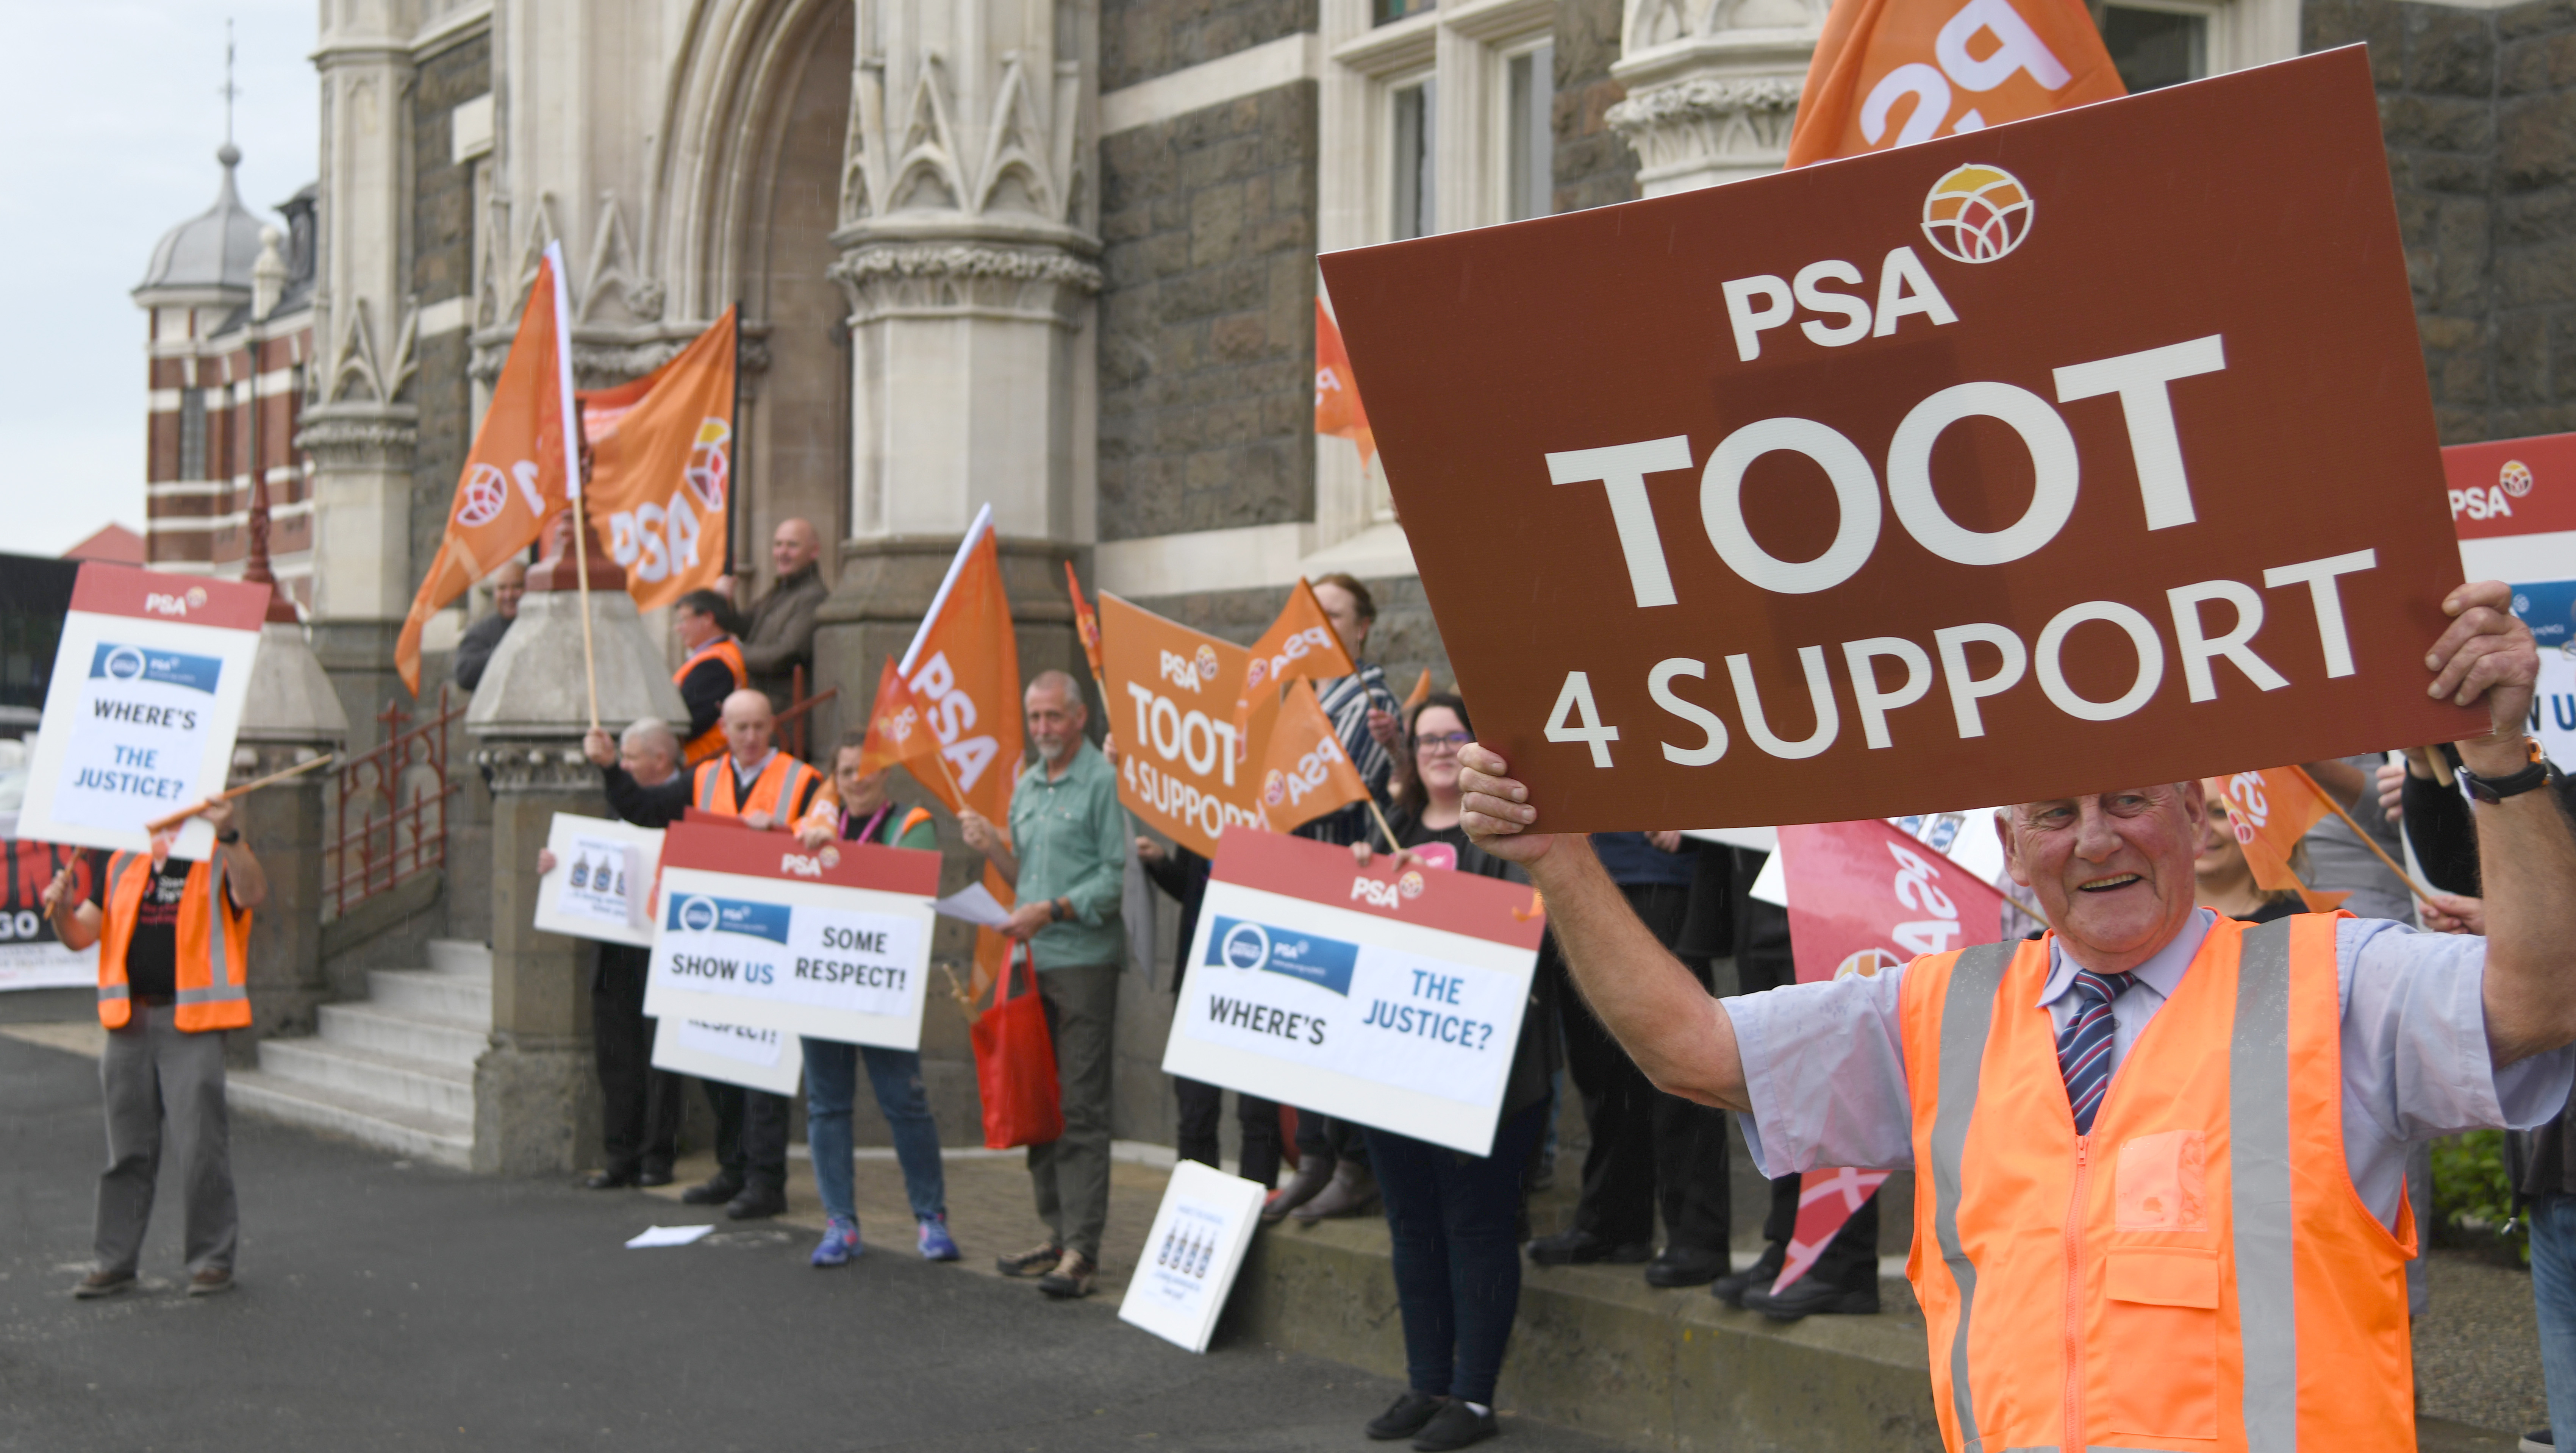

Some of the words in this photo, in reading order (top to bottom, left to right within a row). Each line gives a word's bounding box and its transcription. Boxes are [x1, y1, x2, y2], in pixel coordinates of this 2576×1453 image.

[1722, 247, 1958, 361] PSA
[1545, 334, 2225, 607] TOOT
[2448, 485, 2514, 523] PSA
[145, 592, 187, 617] PSA
[1160, 649, 1201, 694] PSA
[1543, 671, 1620, 768] 4
[1647, 548, 2376, 767] SUPPORT
[92, 698, 197, 730] WHERE'S
[909, 650, 1000, 794] PSA
[1127, 681, 1236, 787] TOOT
[114, 745, 158, 769] THE
[1124, 754, 1137, 792] 4
[73, 767, 184, 798] JUSTICE?
[782, 853, 822, 876] PSA
[1351, 876, 1399, 909] PSA
[823, 927, 887, 954] SOME
[672, 953, 739, 980] SHOW
[745, 962, 774, 985] US
[796, 958, 906, 991] RESPECT!
[1412, 969, 1465, 1006] THE
[1210, 995, 1327, 1046] WHERE'S
[1363, 1000, 1494, 1051] JUSTICE?
